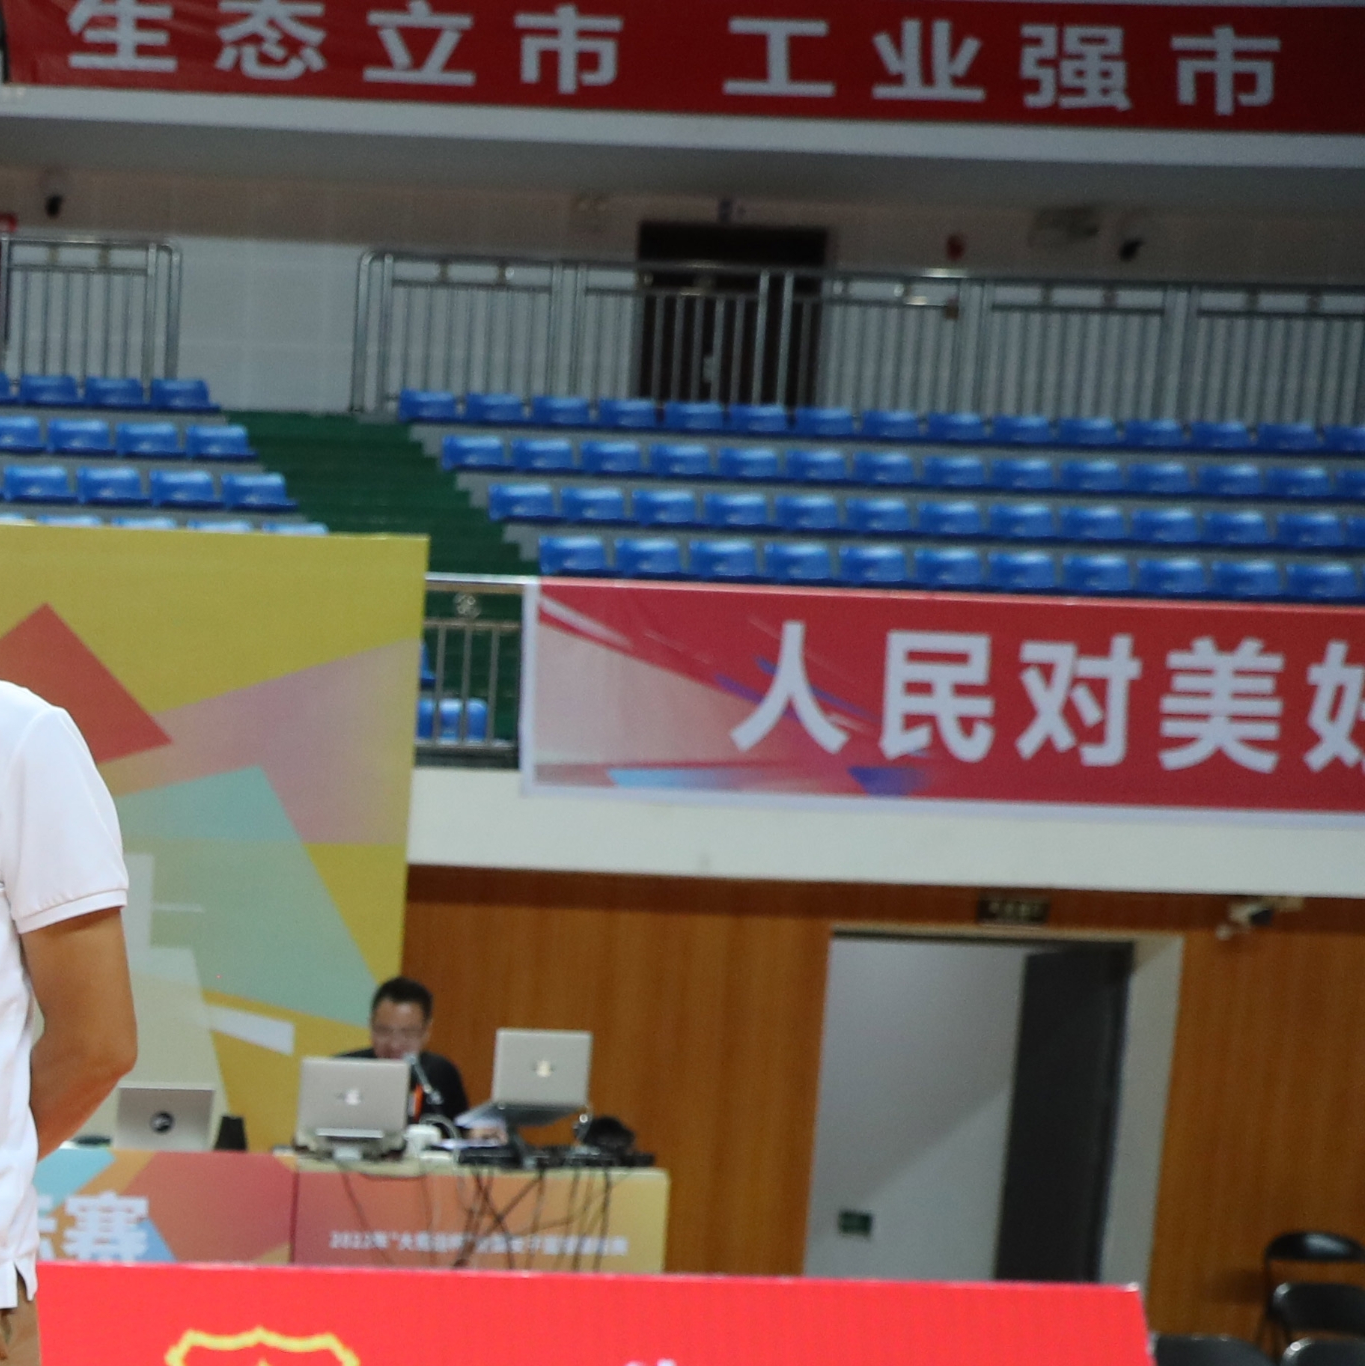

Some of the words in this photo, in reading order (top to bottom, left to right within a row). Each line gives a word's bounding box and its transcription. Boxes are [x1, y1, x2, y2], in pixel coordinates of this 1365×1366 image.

[67, 0, 623, 95] 生态立市
[723, 17, 1280, 116] 工业强市
